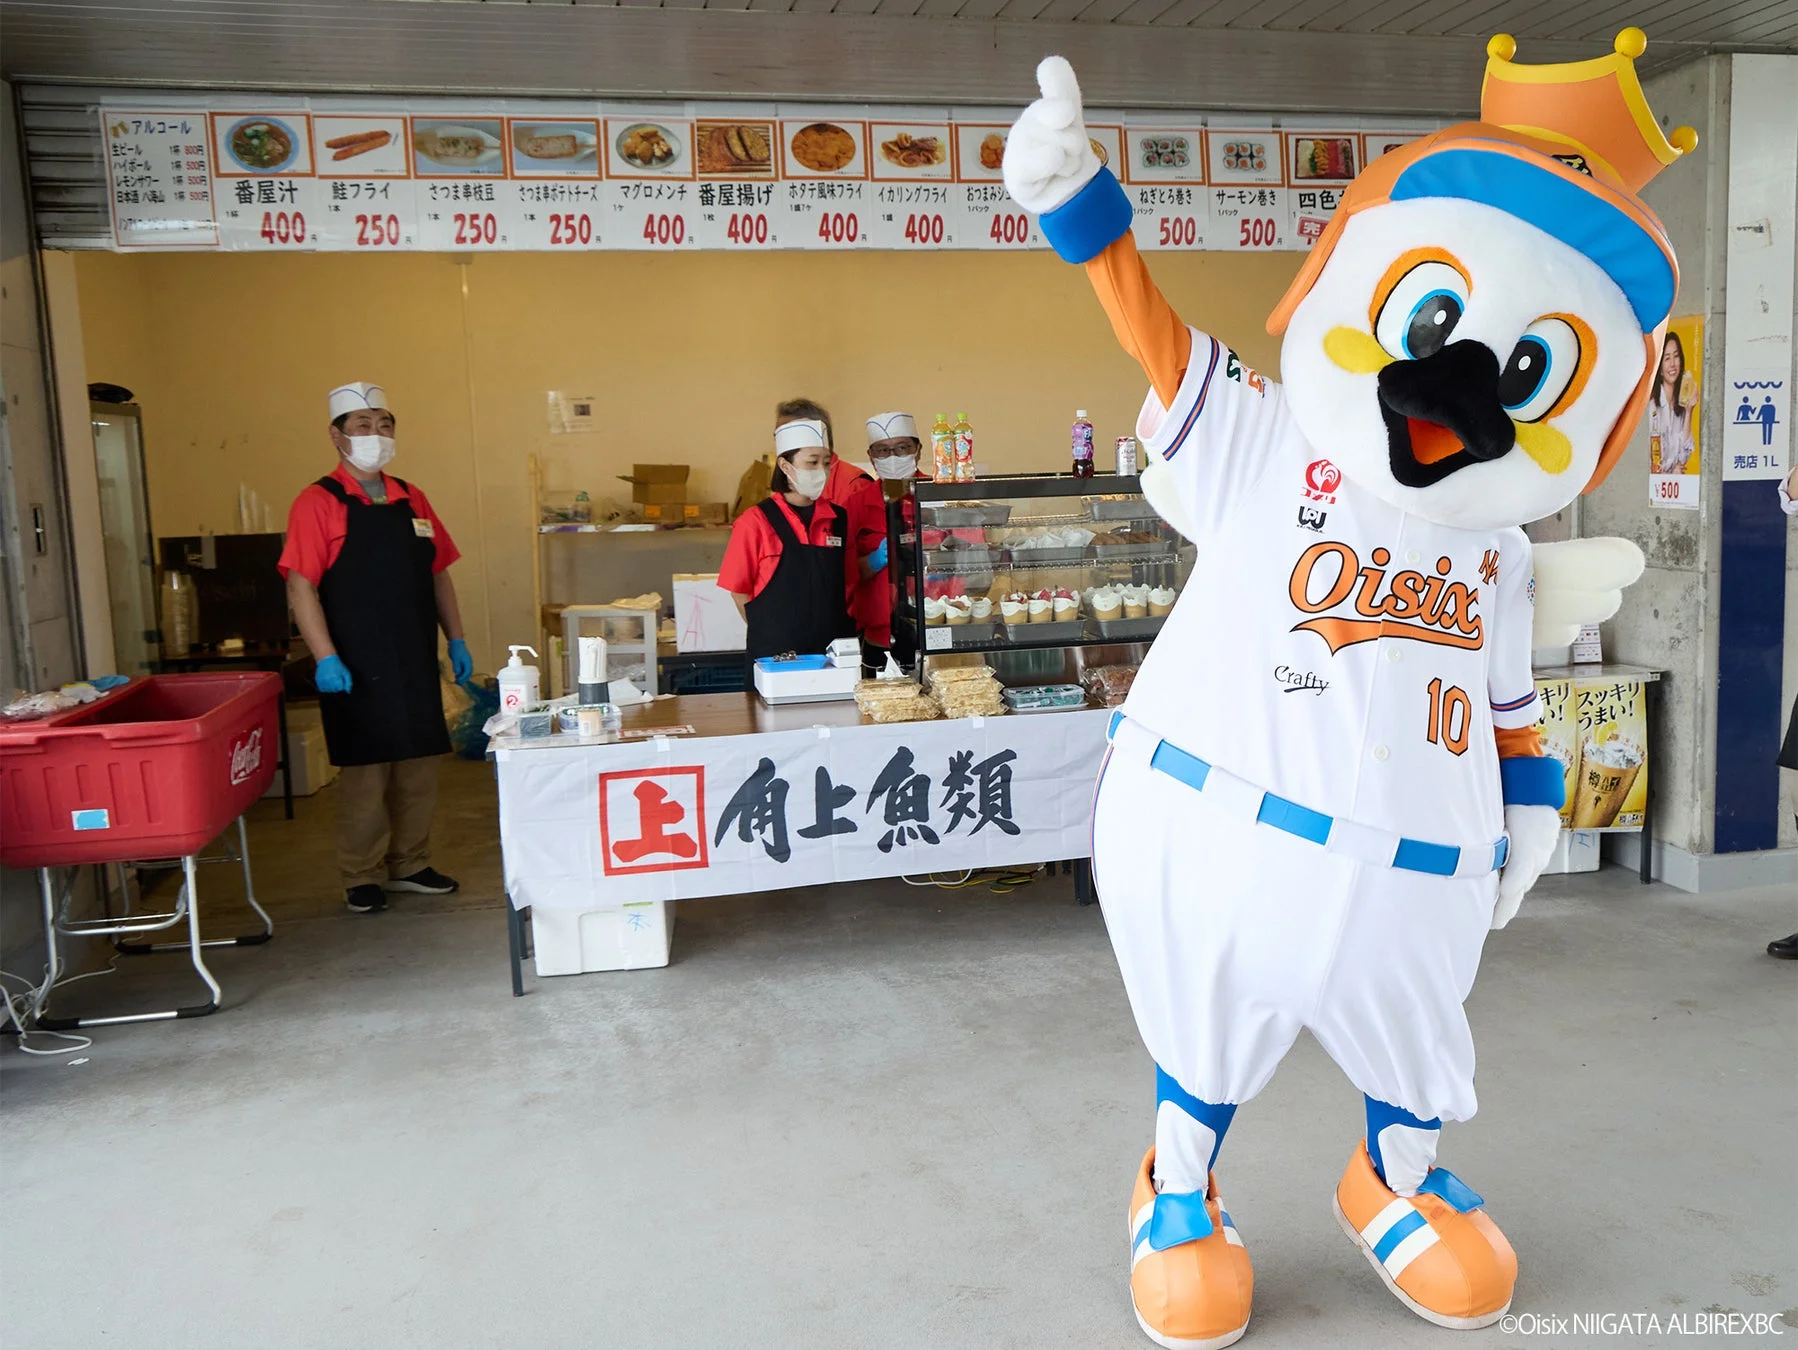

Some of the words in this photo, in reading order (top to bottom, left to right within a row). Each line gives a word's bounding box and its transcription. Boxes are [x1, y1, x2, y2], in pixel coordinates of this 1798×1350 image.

[132, 120, 193, 135] アルコール
[235, 179, 298, 204] 番屋汁
[332, 181, 390, 200] 鮭フライ
[429, 183, 496, 202] さつま串枝豆
[518, 184, 598, 203] さつま串ポテトチーズ
[620, 182, 687, 201] マグロメンチ
[698, 183, 774, 207] 番屋揚げ
[788, 182, 863, 200] ホタテ風味フライ
[878, 185, 948, 204] イカリングフライ
[966, 185, 1011, 202] おつまみシュ
[1139, 187, 1193, 205] ねぎとろ巻き
[1216, 189, 1276, 206] サーモン巻き
[968, 205, 990, 213] 1パック
[1218, 209, 1238, 217] 1パック
[261, 211, 306, 244] 400
[355, 214, 400, 246] 250
[453, 213, 497, 244] 250
[549, 213, 592, 244] 250
[643, 213, 685, 244] 400
[727, 213, 768, 244] 400
[818, 212, 858, 243] 400
[905, 213, 944, 244] 400
[990, 213, 1028, 243] 400
[1159, 216, 1196, 246] 500
[1240, 218, 1276, 247] 500
[1734, 454, 1758, 469] 売店
[1289, 541, 1484, 646] Oisix
[1274, 665, 1331, 696] Crafty
[1540, 683, 1570, 706] キリ
[1577, 681, 1640, 710] スッキリ
[1426, 677, 1471, 757] 10
[714, 745, 1021, 864] 角上魚類
[611, 779, 698, 863] 上
